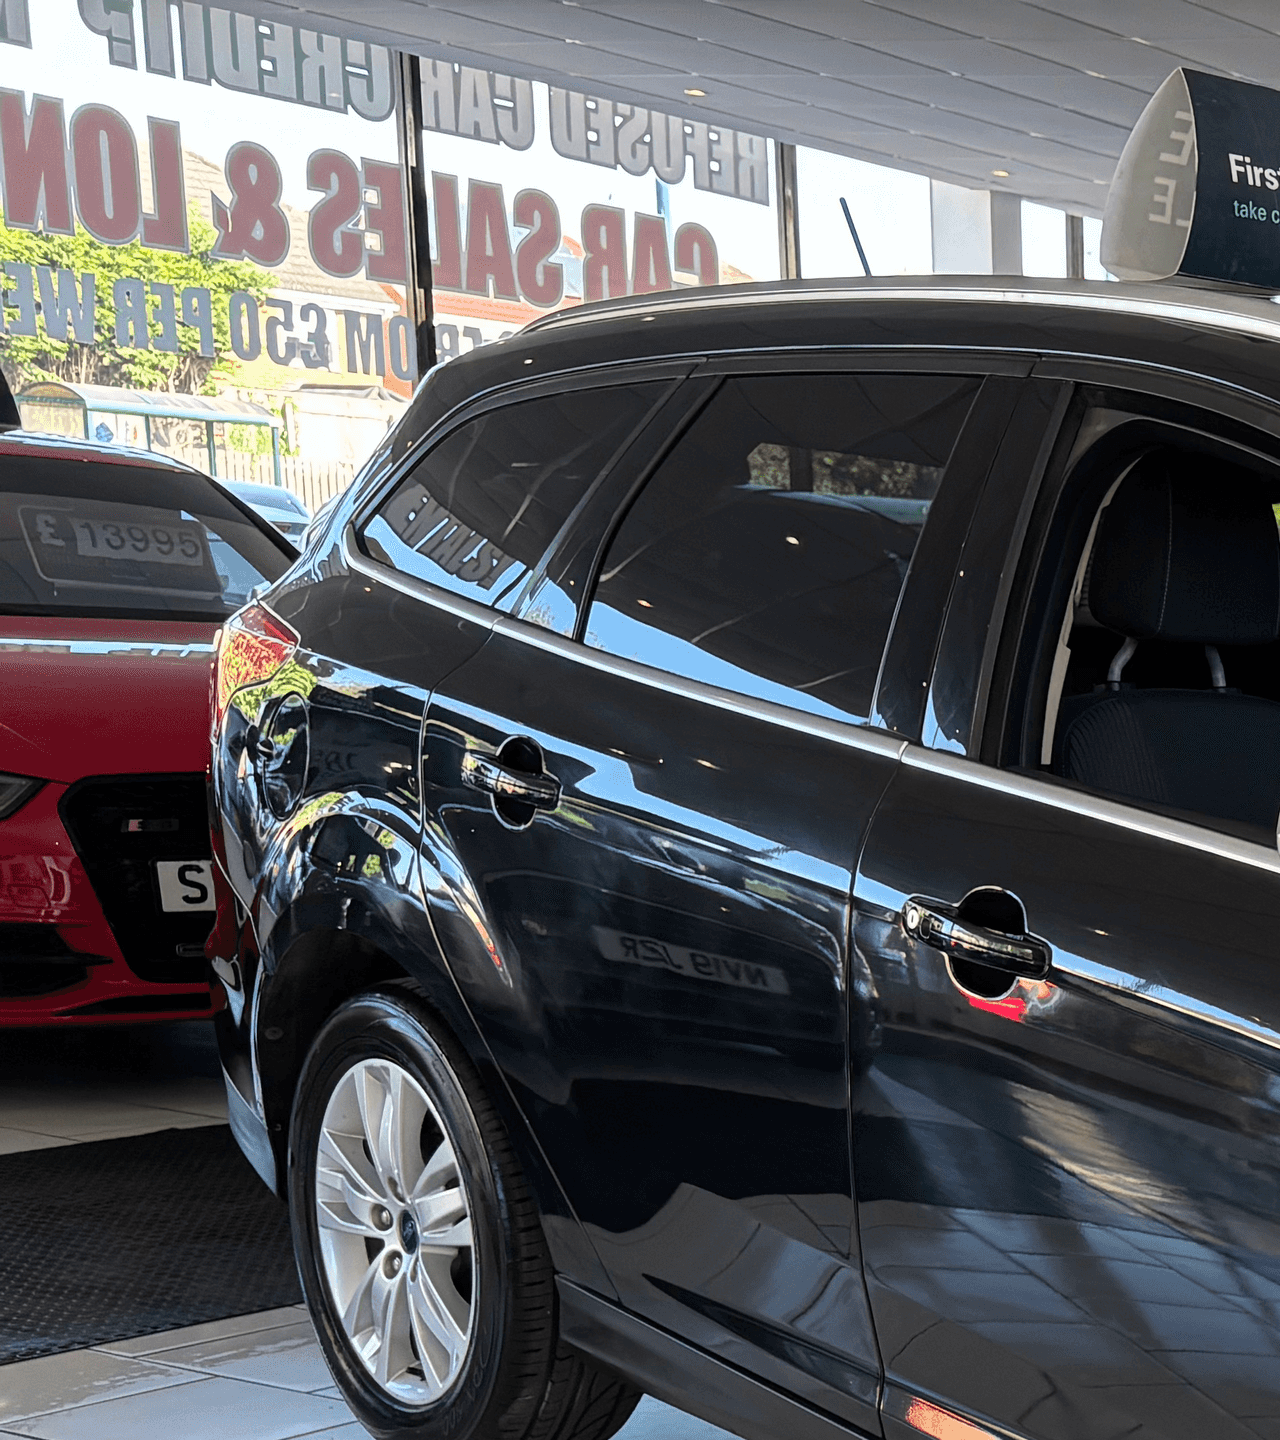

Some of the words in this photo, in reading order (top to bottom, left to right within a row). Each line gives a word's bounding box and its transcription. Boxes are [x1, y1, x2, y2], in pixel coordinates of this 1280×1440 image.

[1233, 200, 1267, 221] take
[36, 513, 66, 547] £
[80, 522, 200, 559] 13995
